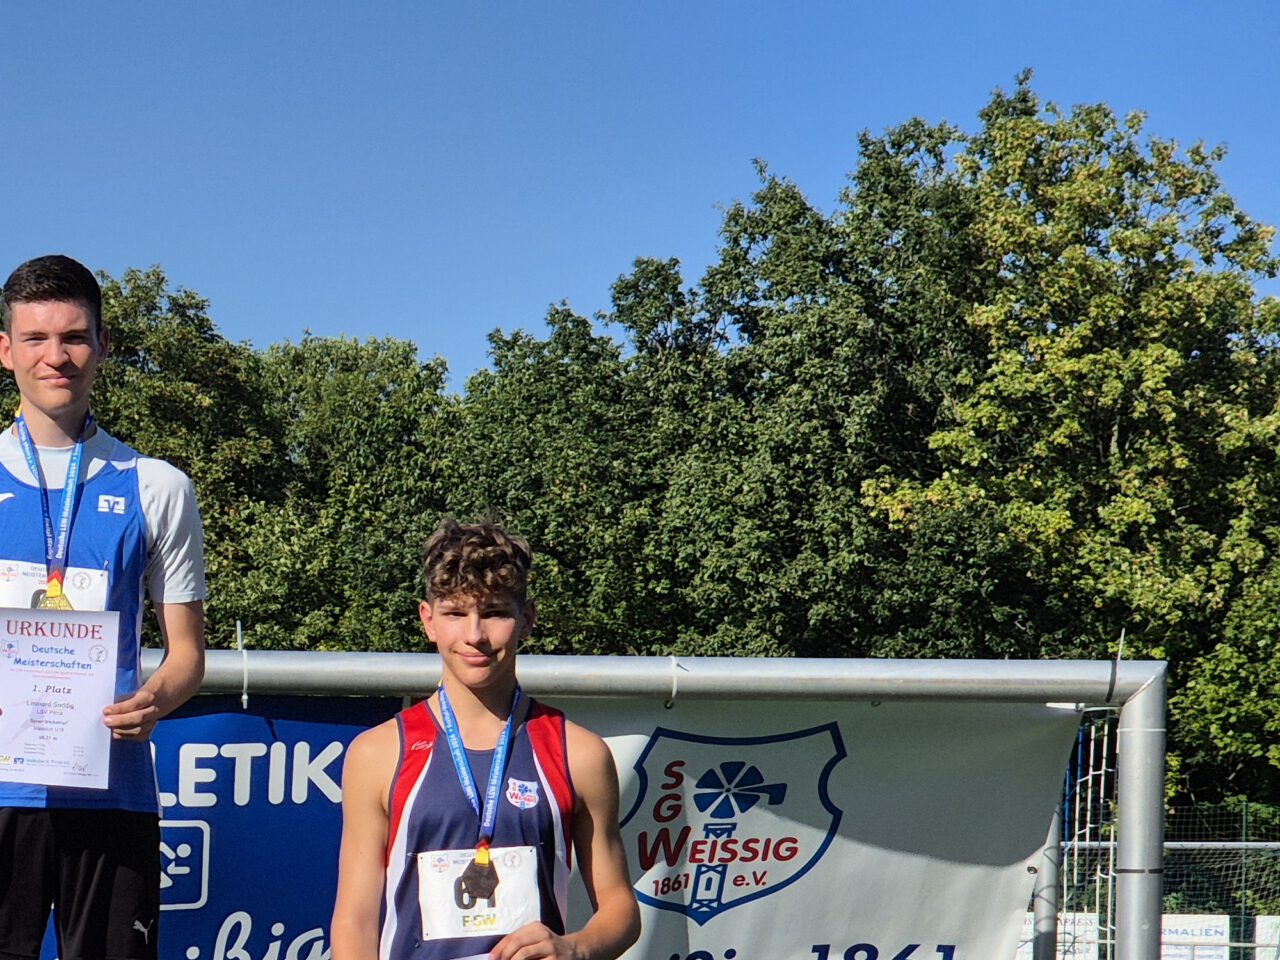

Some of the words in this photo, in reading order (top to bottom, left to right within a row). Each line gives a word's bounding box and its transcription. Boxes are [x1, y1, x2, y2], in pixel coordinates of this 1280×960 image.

[6, 620, 103, 639] URKUNDE
[31, 644, 75, 655] Deutsche
[13, 658, 92, 669] Meisterschaften
[32, 684, 41, 693] 1.
[45, 685, 72, 694] Platz
[482, 798, 495, 827] Deutsche
[637, 825, 799, 872] WEISSIG
[652, 873, 690, 897] 1861
[732, 870, 768, 887] e.V.
